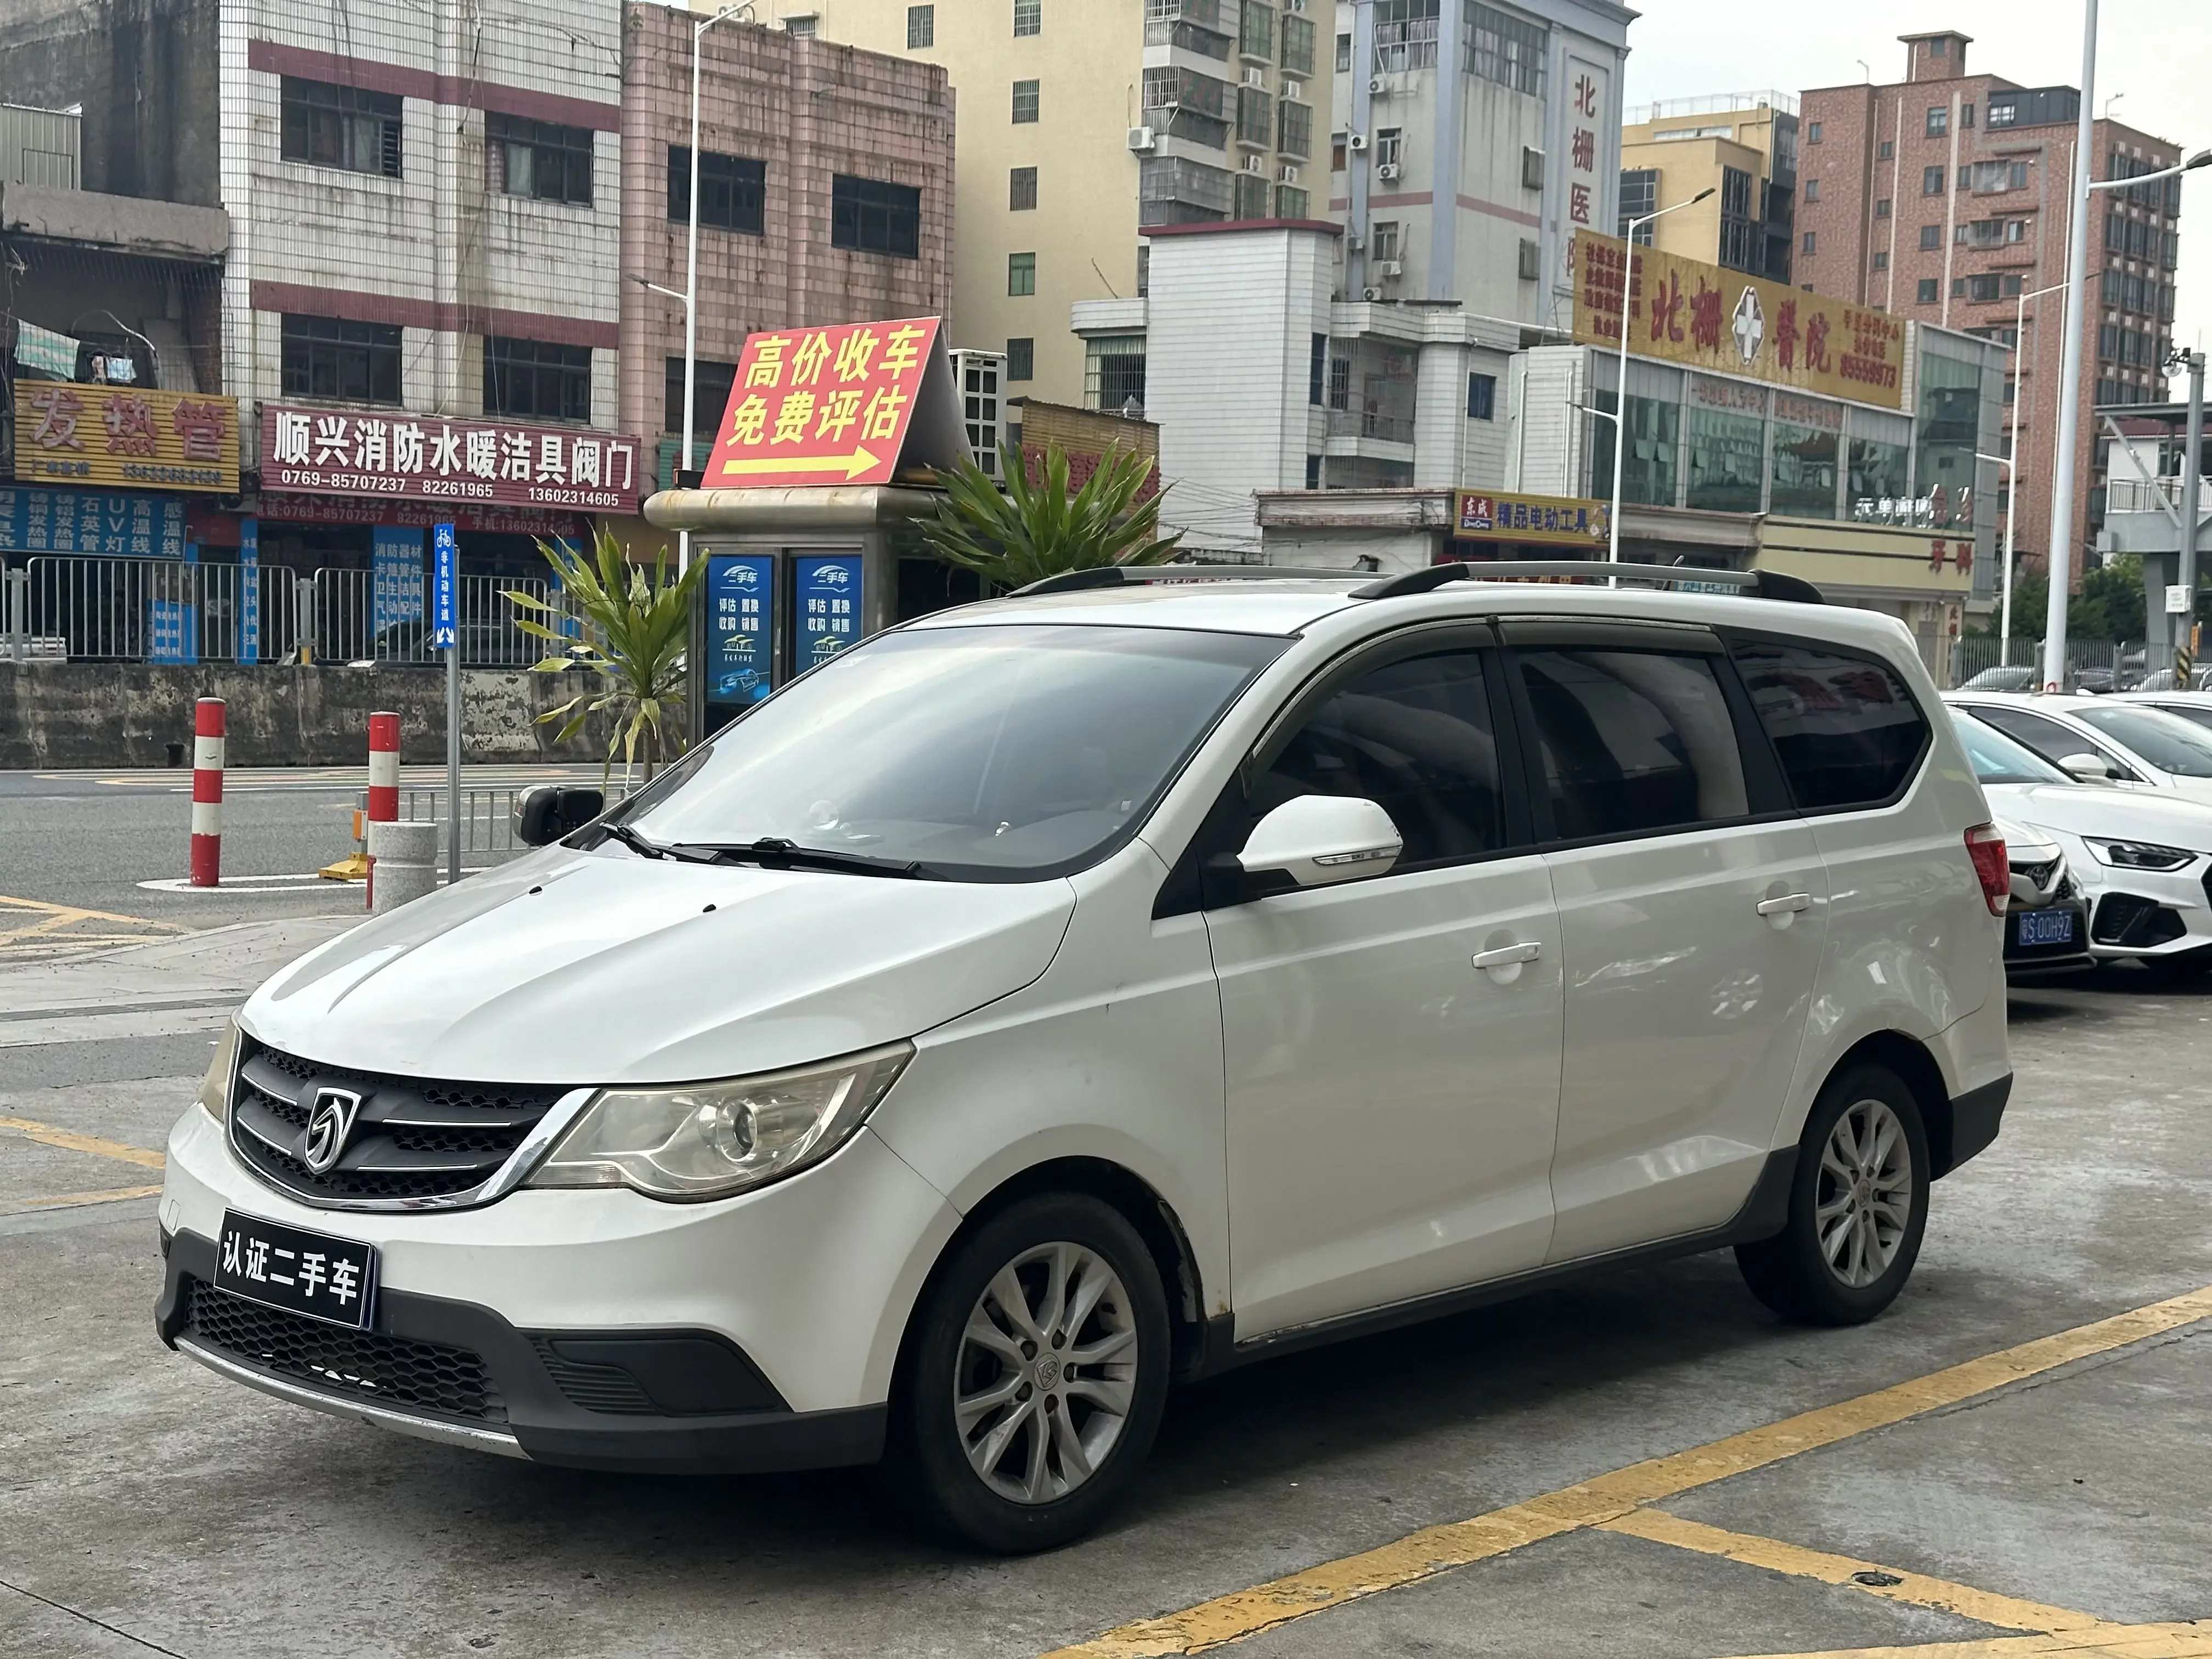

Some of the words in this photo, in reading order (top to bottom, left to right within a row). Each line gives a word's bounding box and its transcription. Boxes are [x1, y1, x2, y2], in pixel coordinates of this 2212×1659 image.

[744, 324, 926, 388] 高价收车
[30, 388, 226, 461] 发热管
[726, 384, 908, 447] 免费评估
[273, 411, 633, 490] 顺兴消防水暖洁具阀门
[281, 470, 406, 492] 0769-85707237
[422, 479, 493, 498] 82261965
[528, 487, 619, 506] 13602314605
[80, 496, 101, 552] 石英管
[375, 543, 422, 558] 消防器材
[441, 550, 449, 622] 非机动车道
[728, 572, 758, 584] 二手车
[817, 572, 849, 584] 二手车
[719, 598, 736, 613] 评估
[741, 599, 759, 613] 置换
[808, 599, 826, 613] 评估
[832, 599, 850, 613] 置换
[719, 617, 736, 631] 收购
[741, 617, 759, 631] 销售
[808, 618, 826, 632] 收购
[832, 618, 850, 633] 销售
[222, 1230, 360, 1306] 认证二手车
